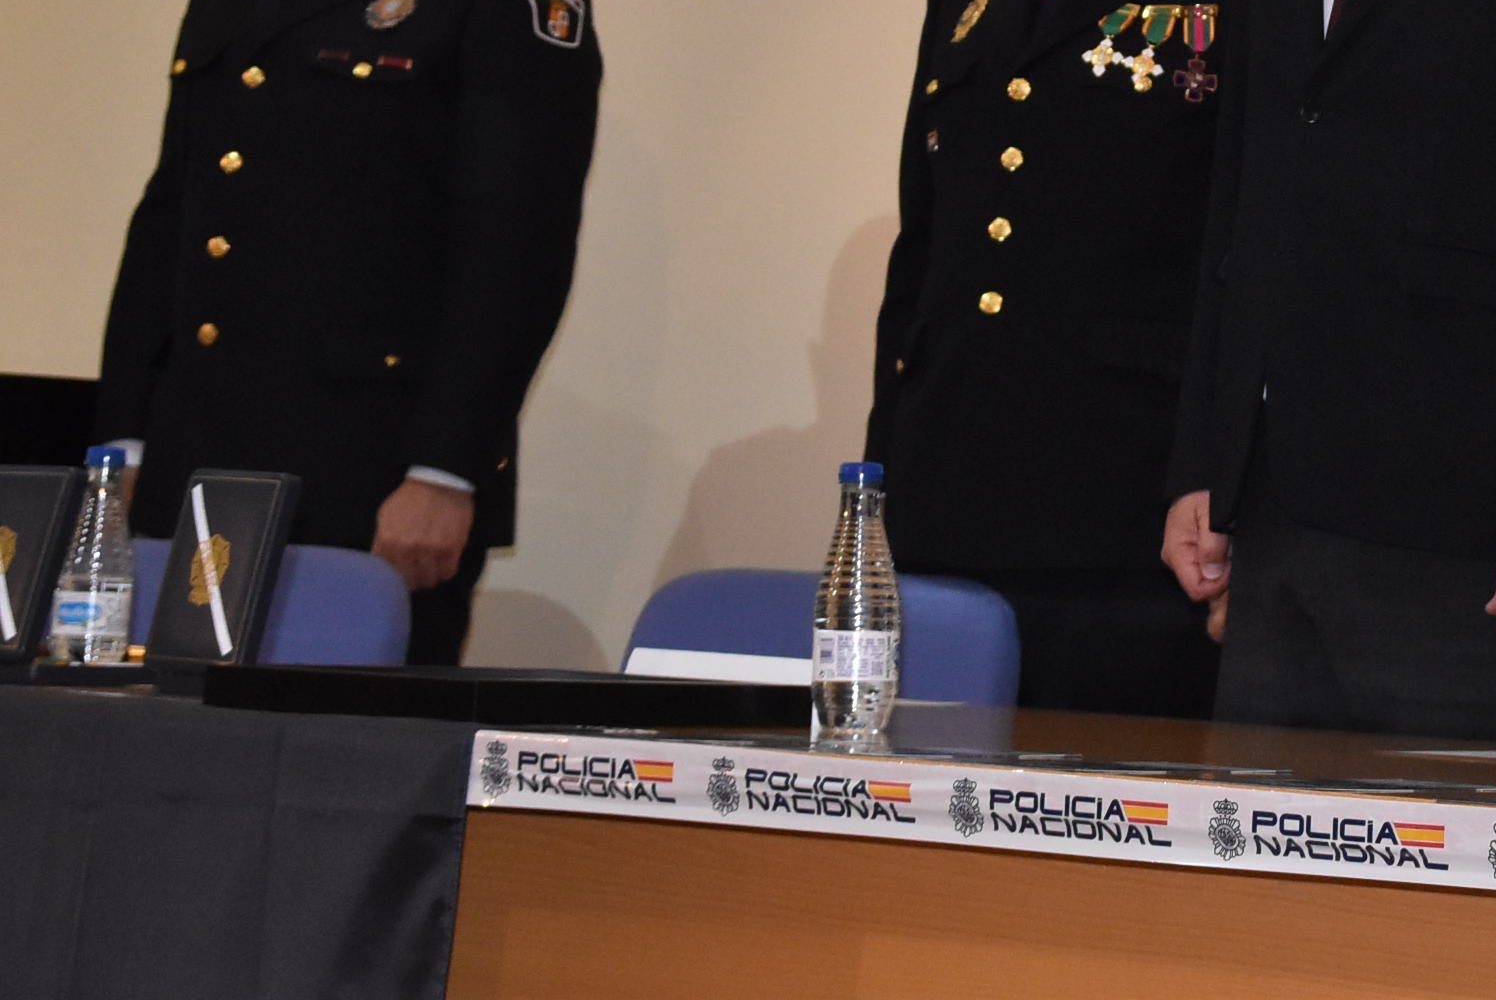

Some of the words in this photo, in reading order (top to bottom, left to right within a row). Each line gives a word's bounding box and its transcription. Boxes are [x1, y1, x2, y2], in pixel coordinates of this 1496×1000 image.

[516, 773, 676, 803] NACIONAL
[745, 790, 915, 823] NACIONAL
[990, 811, 1172, 847] NACIONAL
[1253, 834, 1449, 870] NACIONAL
